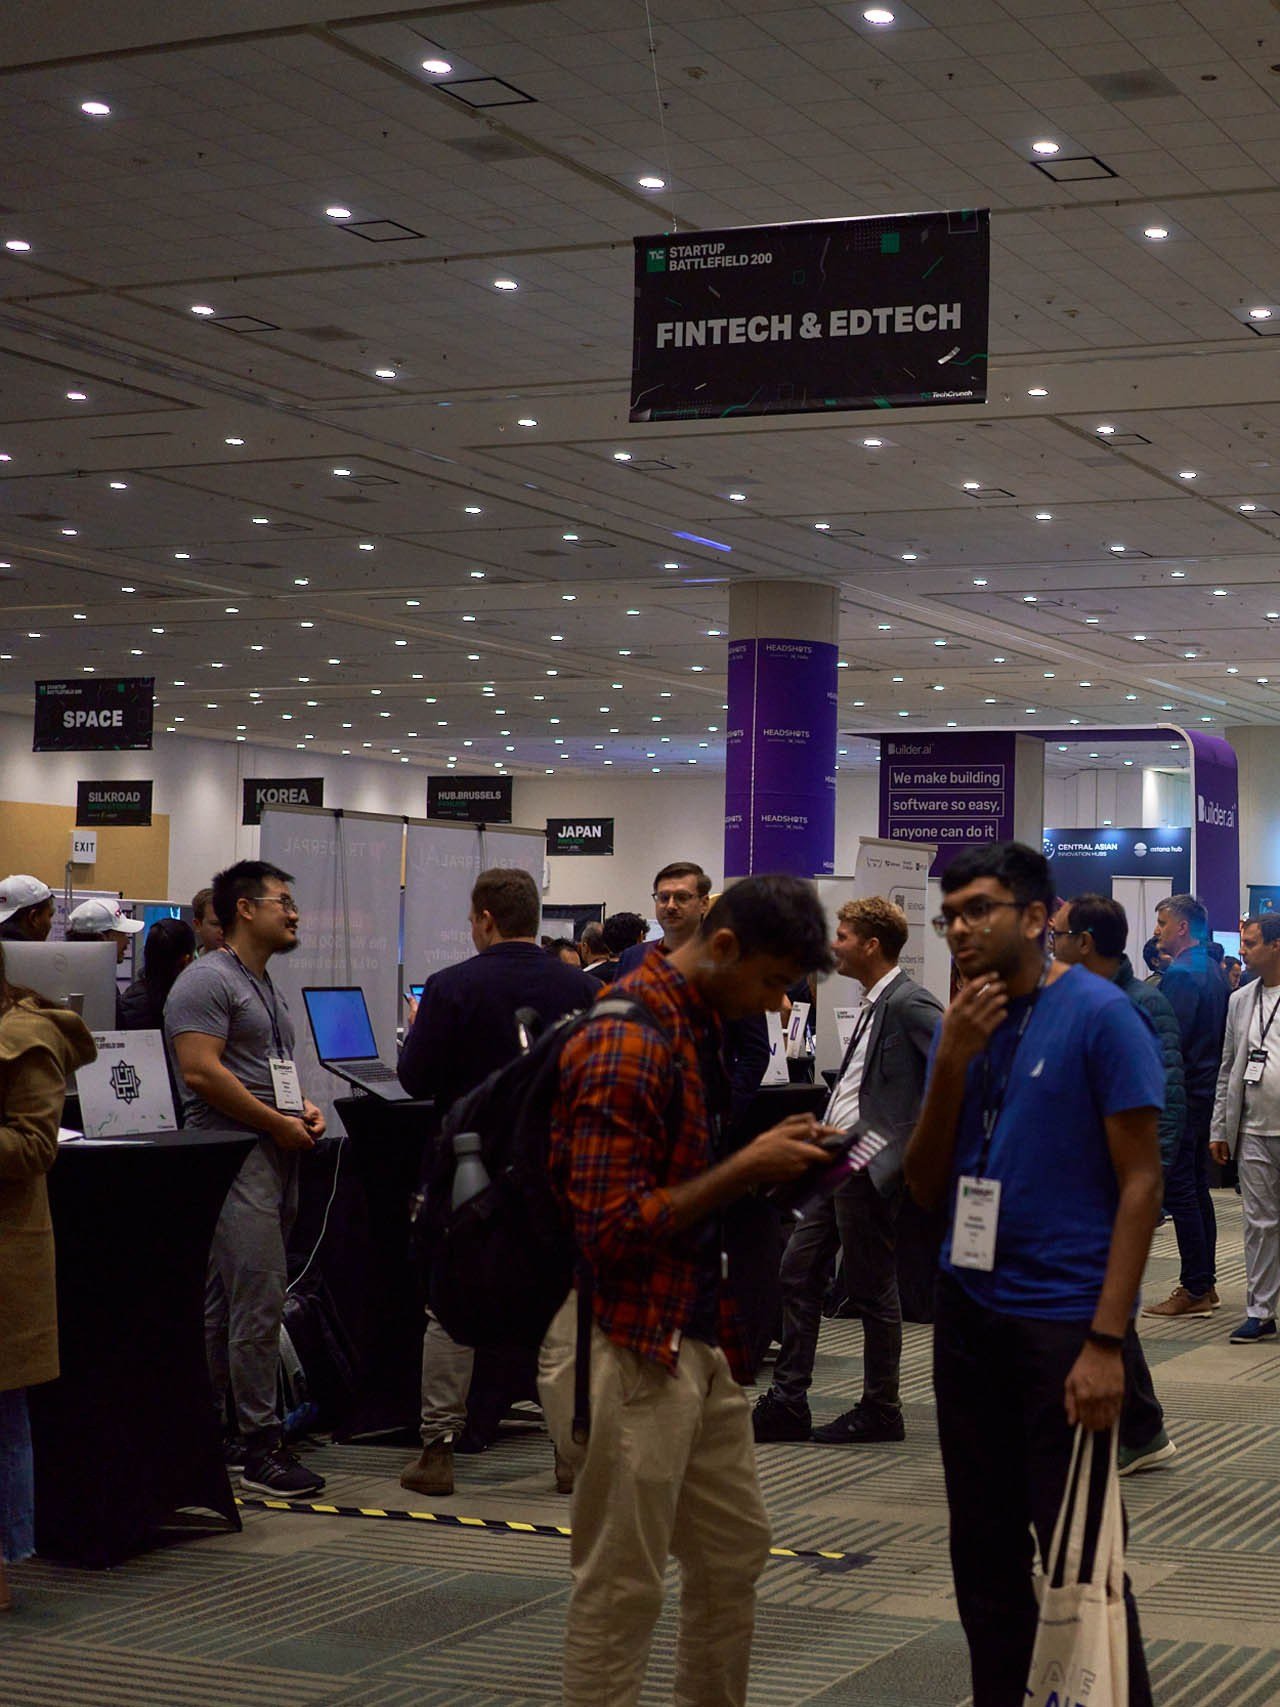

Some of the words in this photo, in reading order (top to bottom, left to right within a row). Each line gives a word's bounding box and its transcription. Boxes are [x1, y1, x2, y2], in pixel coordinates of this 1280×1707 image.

[668, 243, 726, 258] STARTUP
[668, 254, 749, 272] BATTLEFIELD
[750, 252, 773, 266] 200
[656, 314, 792, 348] FINTECH
[799, 312, 823, 339] &
[829, 303, 962, 337] EDTECH
[766, 644, 813, 654] HEADSHOTS
[63, 710, 123, 728] SPACE
[763, 728, 811, 738] HEADSHOTS
[893, 772, 911, 784] We
[914, 771, 947, 784] make
[950, 771, 1001, 786] building
[88, 791, 140, 802] SILKROAD
[256, 789, 309, 804] KOREA
[438, 791, 502, 800] HUB.BRUSSELS
[892, 798, 949, 811] software
[951, 801, 966, 811] so
[968, 801, 1000, 813] easy.
[761, 814, 809, 824] HEADSHOTS
[558, 825, 602, 838] JAPAN
[892, 827, 938, 840] anyone
[940, 827, 963, 838] can
[966, 825, 982, 838] do
[984, 825, 995, 838] it
[74, 841, 95, 853] EXIT
[1058, 843, 1093, 851] CENTRAL
[1094, 843, 1118, 851] ASIAN
